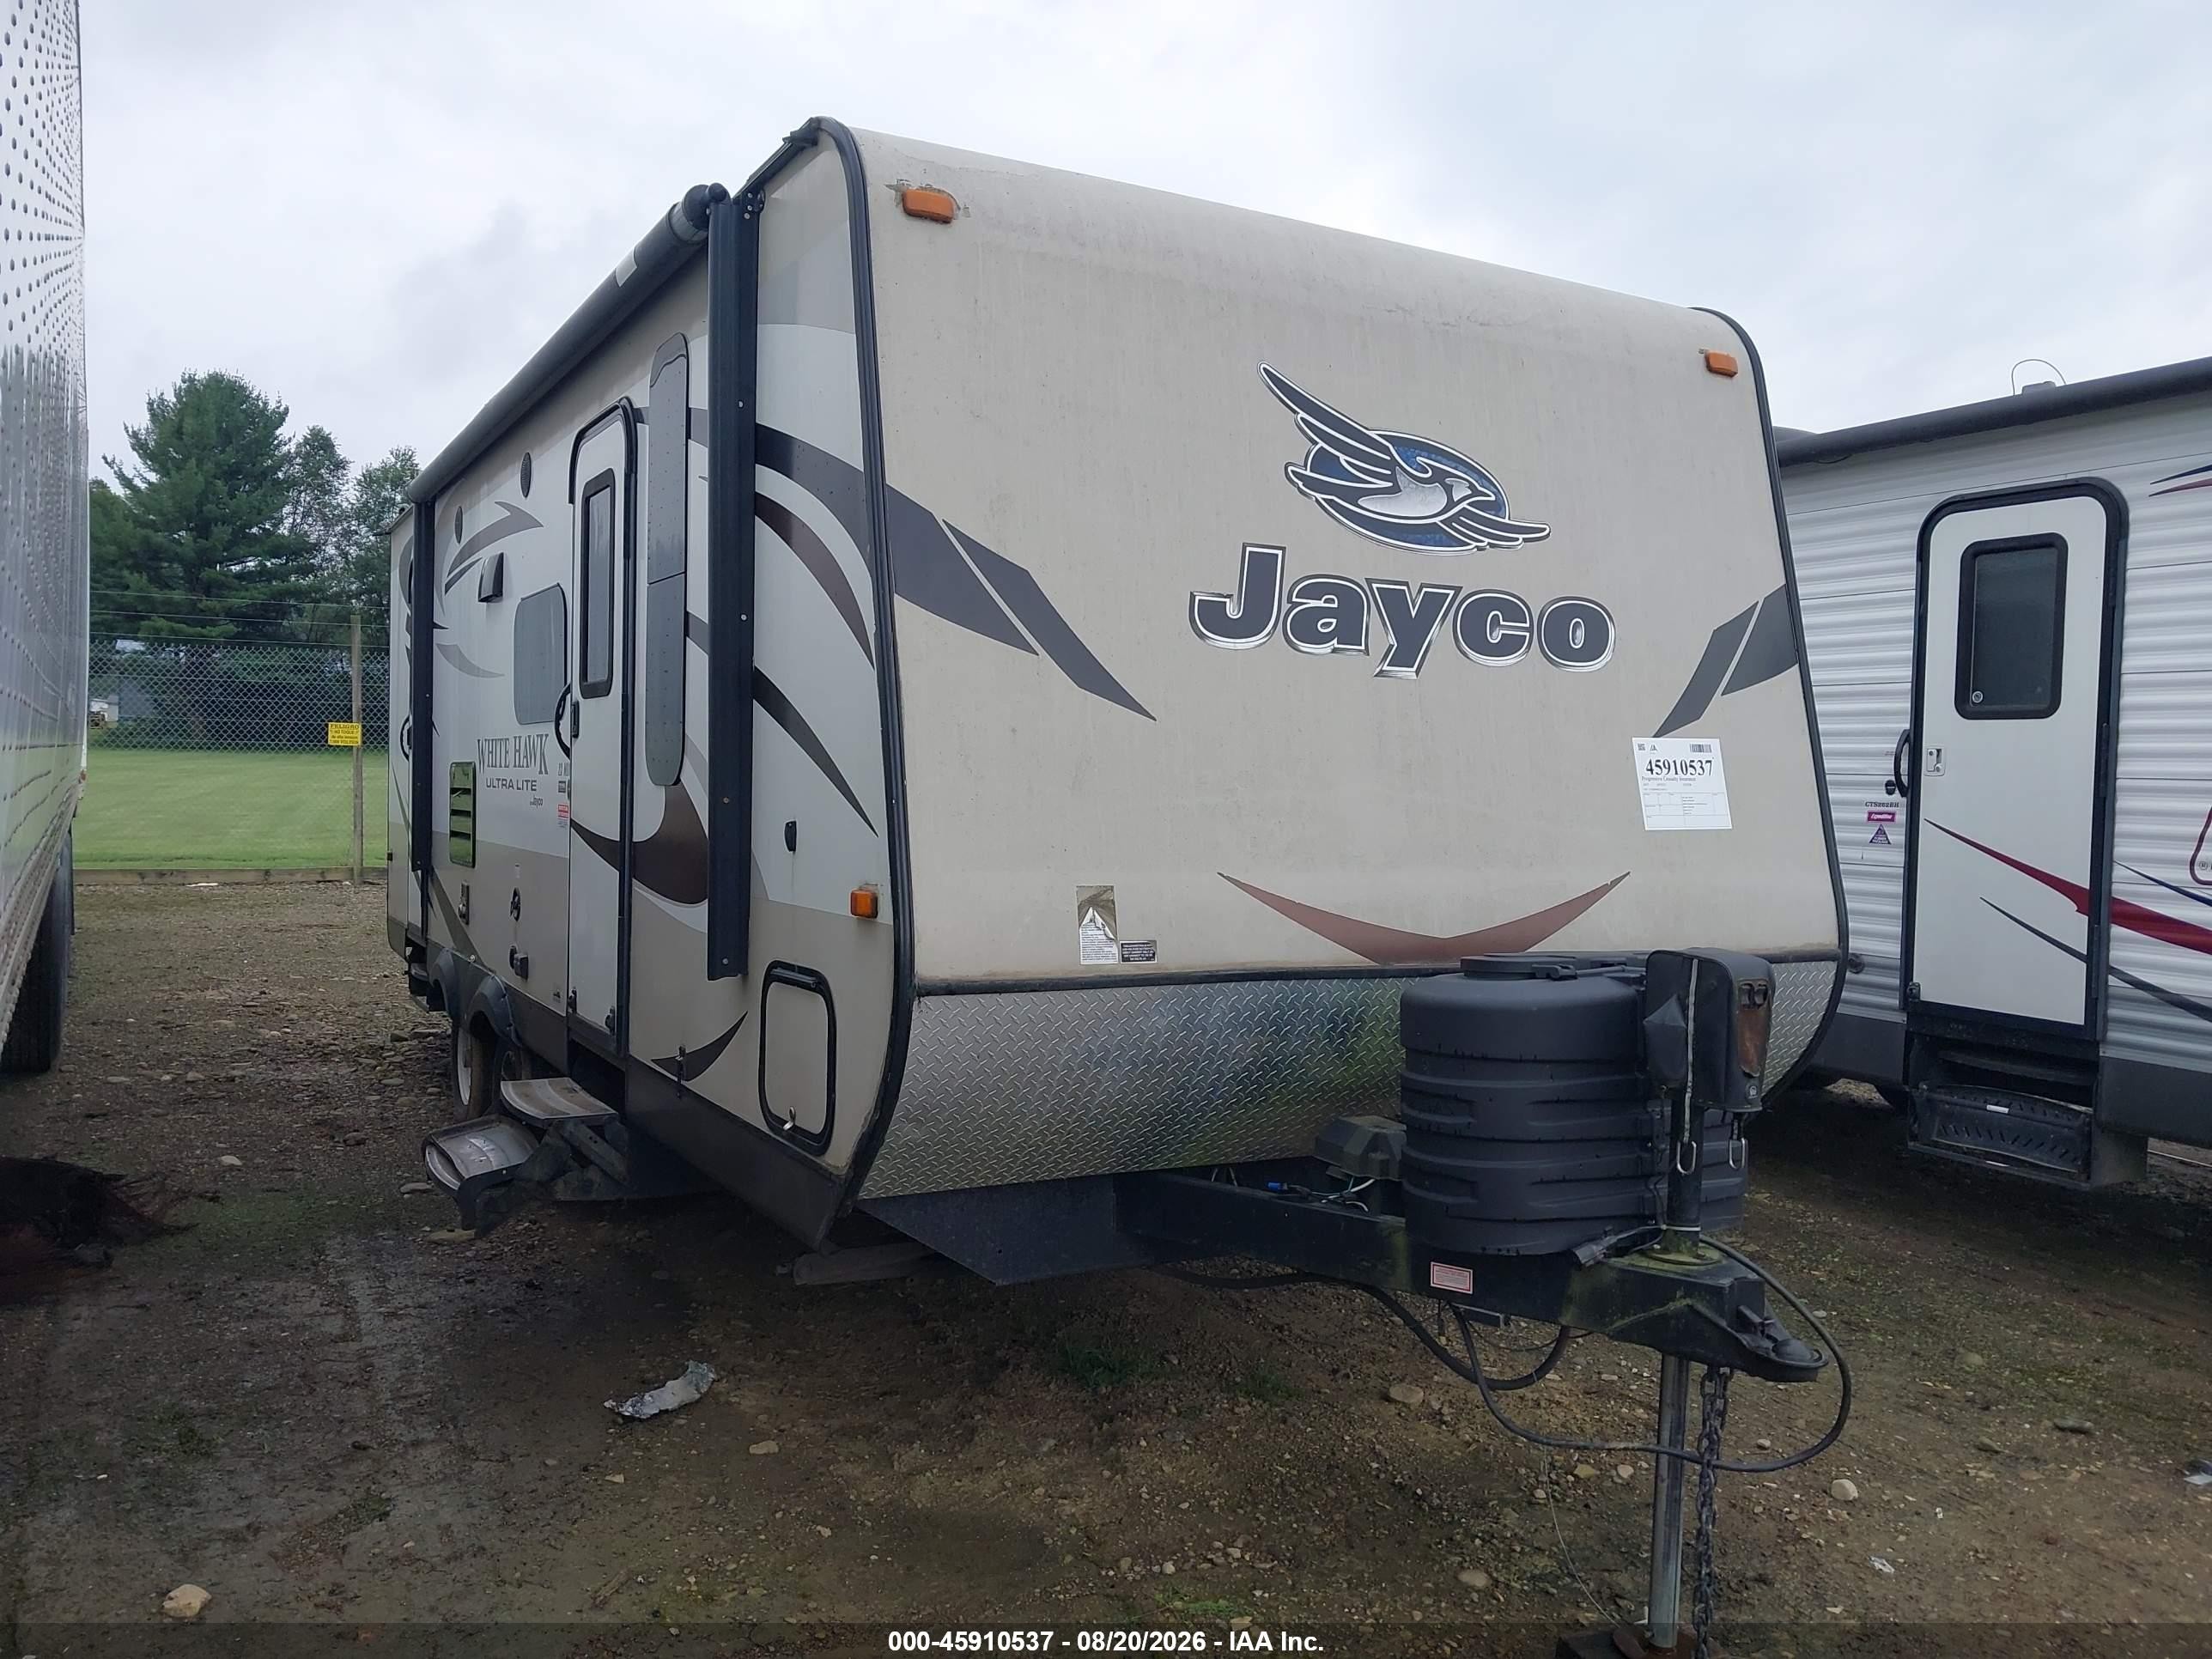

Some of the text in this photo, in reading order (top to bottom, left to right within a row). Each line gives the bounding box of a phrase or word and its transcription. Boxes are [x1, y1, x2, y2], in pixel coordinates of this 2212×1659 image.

[1188, 543, 1617, 679] Jayco
[477, 733, 550, 775] WHITE HAWK
[1645, 758, 1713, 776] 45910537
[486, 777, 538, 792] ULTRA LITE
